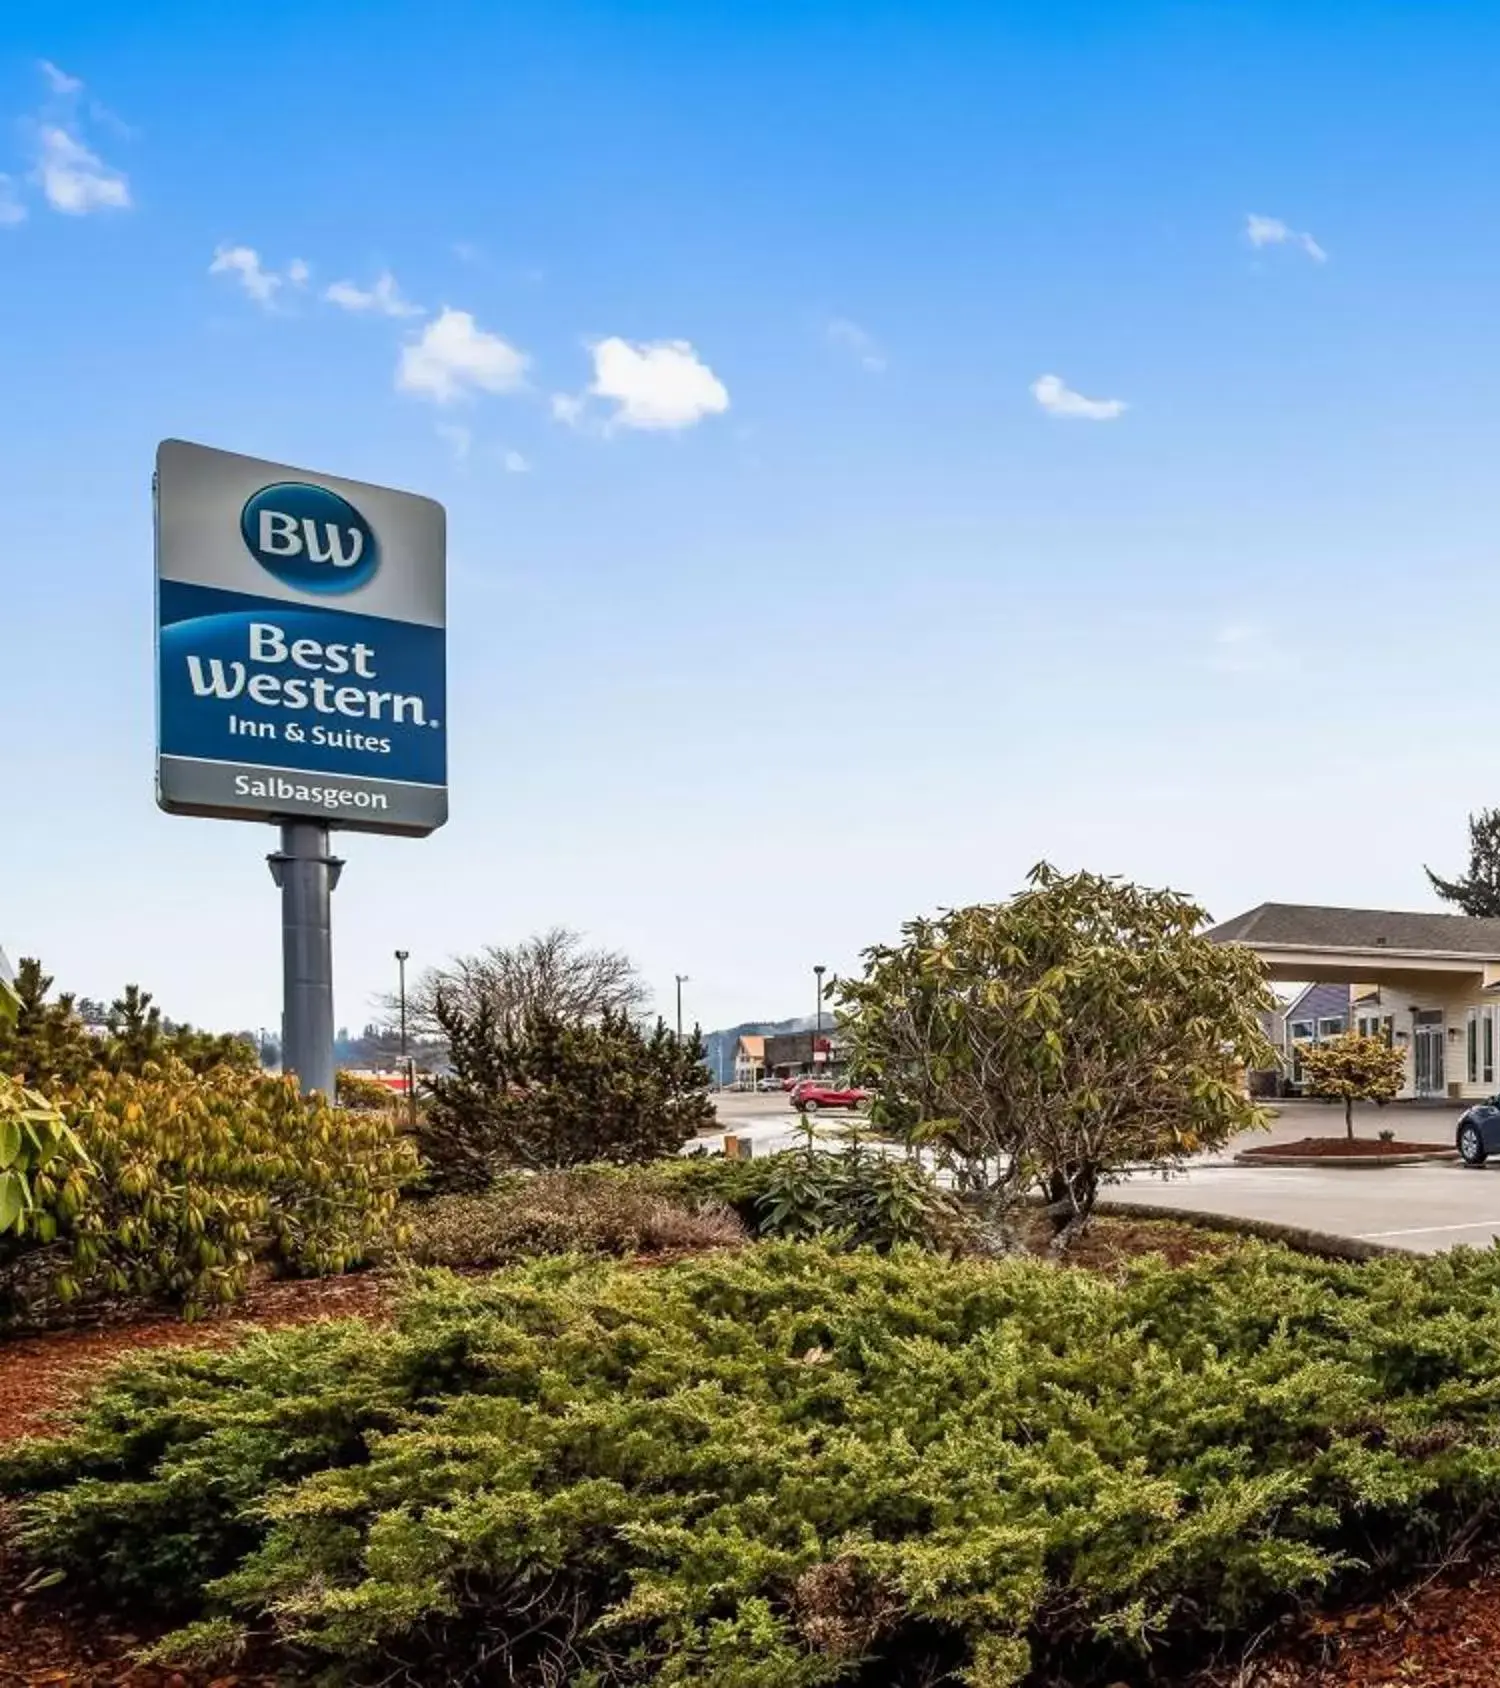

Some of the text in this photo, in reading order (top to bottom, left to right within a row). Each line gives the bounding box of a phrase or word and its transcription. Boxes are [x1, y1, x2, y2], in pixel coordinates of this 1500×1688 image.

[258, 509, 363, 568] BW
[249, 622, 377, 679] Best
[228, 714, 392, 754] Inn & Suites
[234, 774, 388, 810] Salbasgeon
